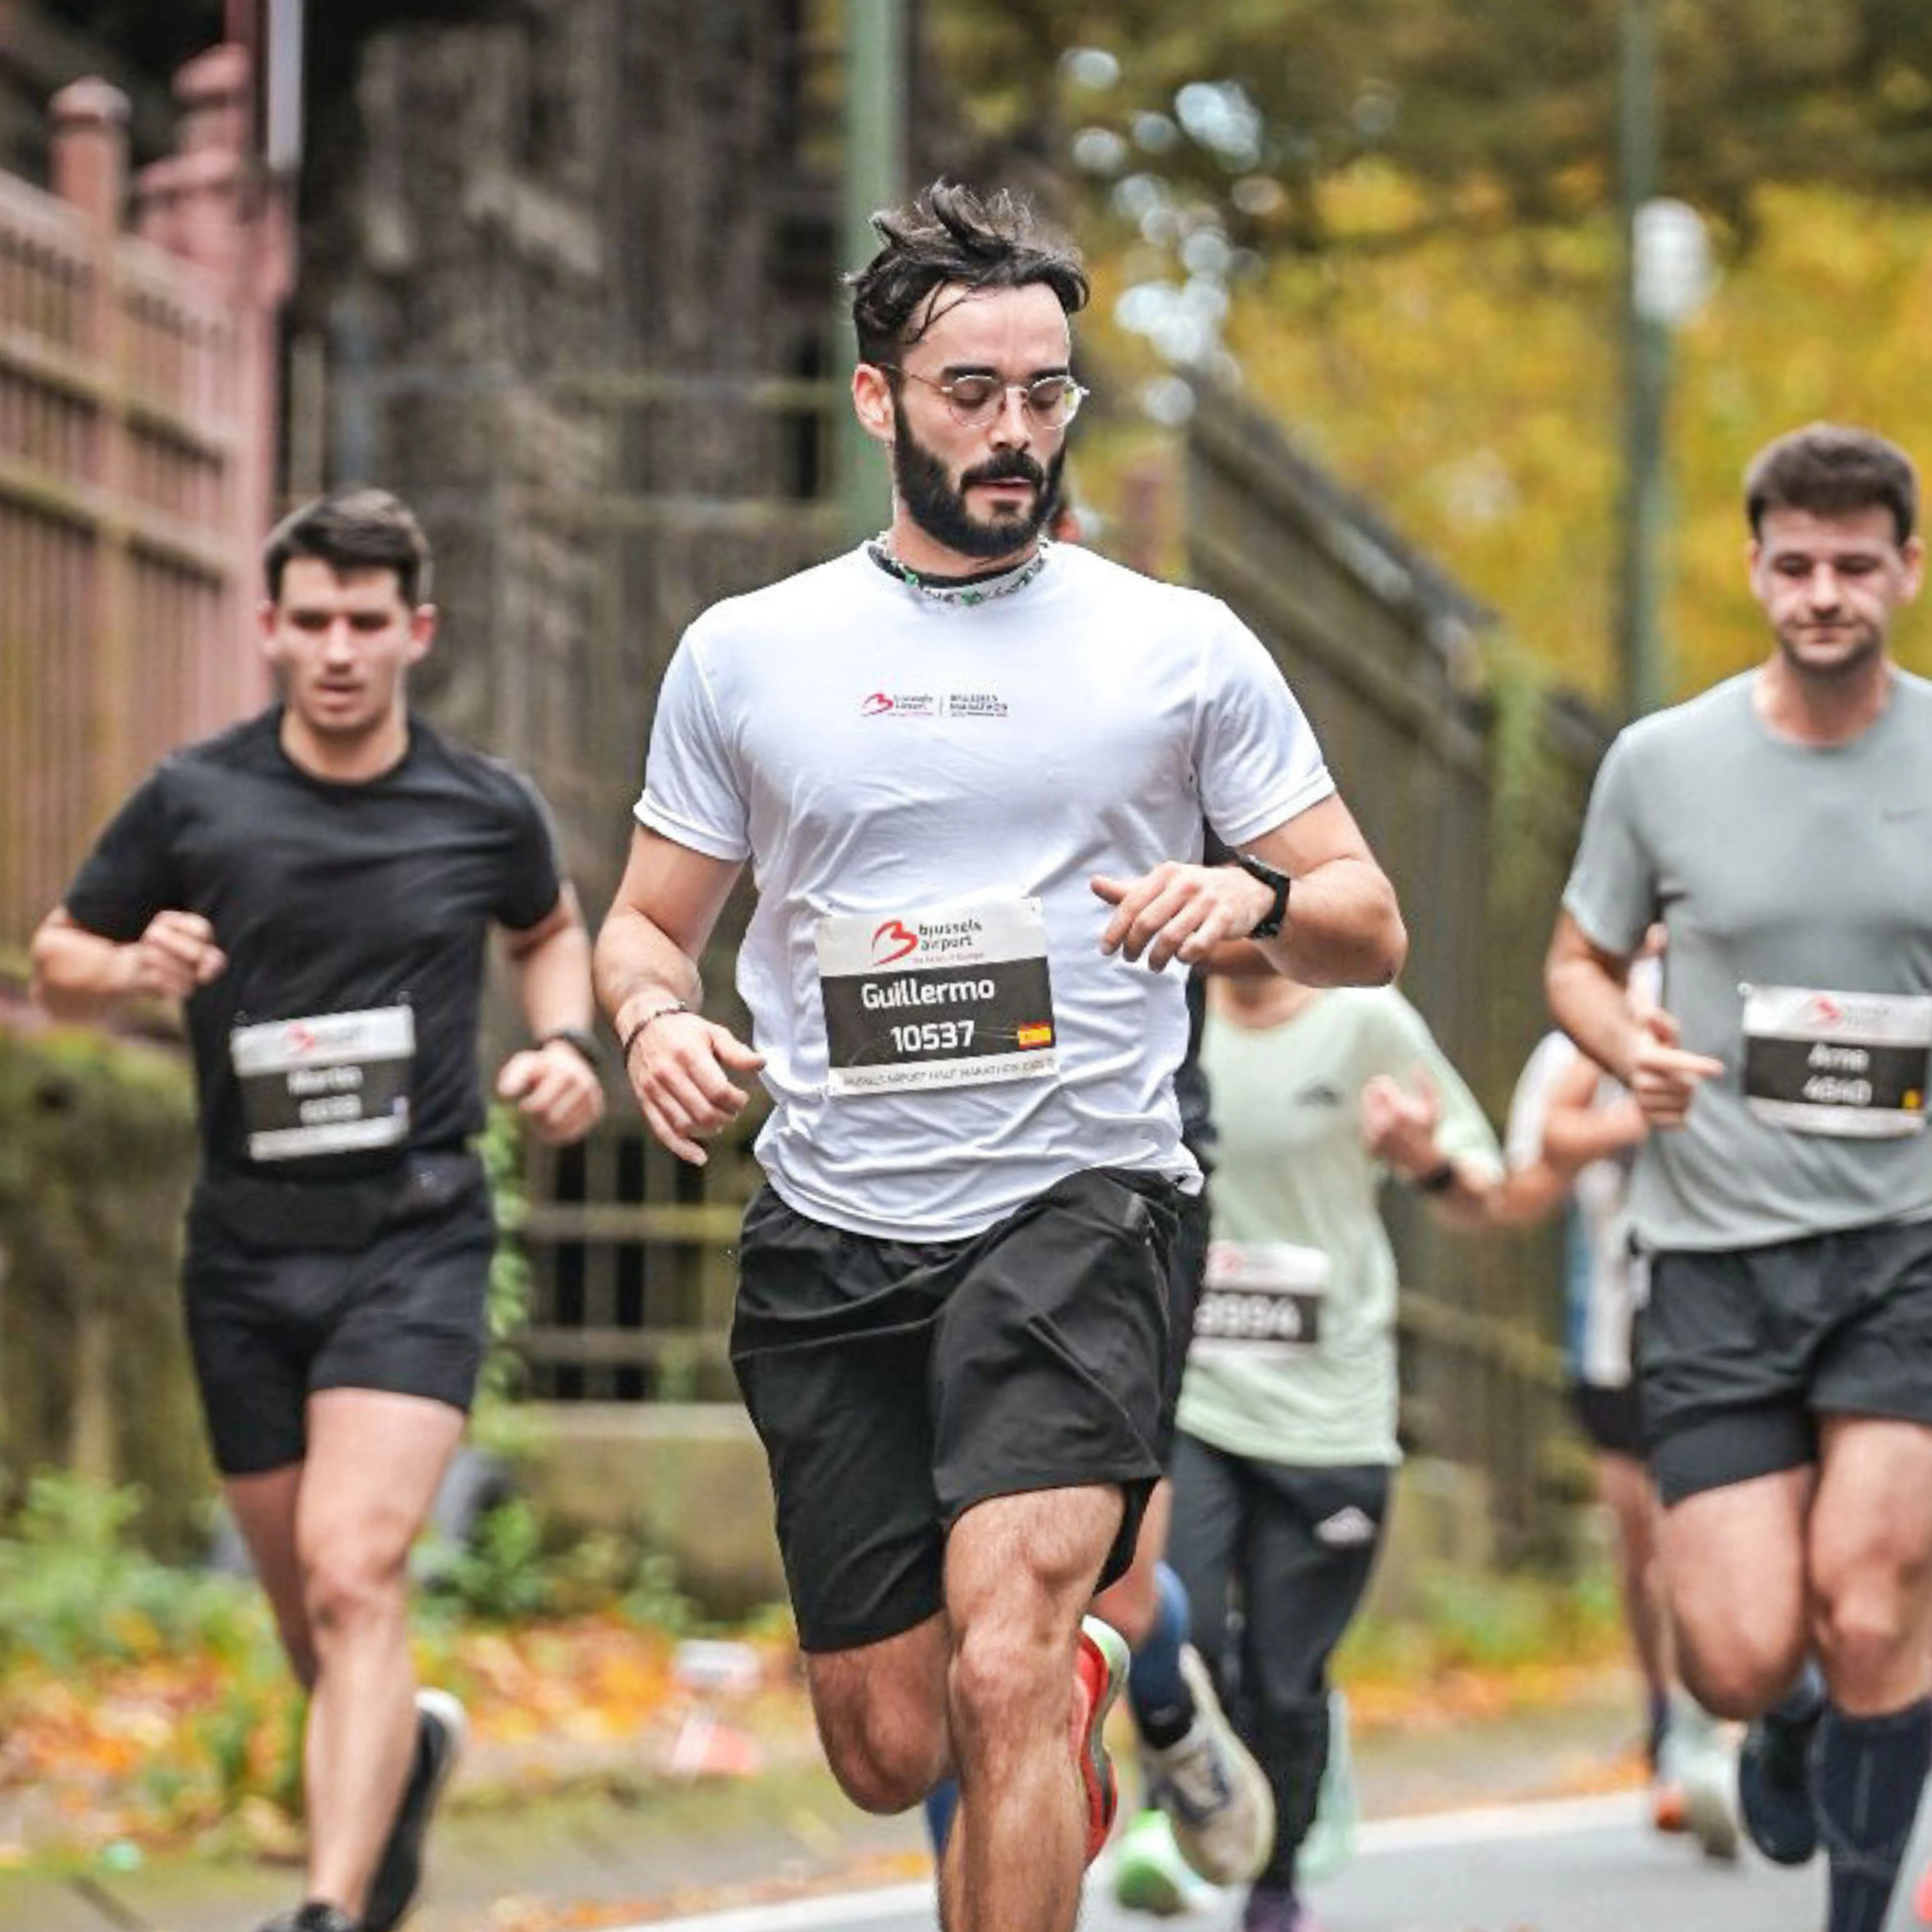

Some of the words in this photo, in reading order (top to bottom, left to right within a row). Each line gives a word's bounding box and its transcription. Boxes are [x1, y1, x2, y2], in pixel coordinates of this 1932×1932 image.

[920, 934, 973, 952] airport
[862, 978, 995, 1009] Guillermo
[890, 1020, 975, 1053] 10537
